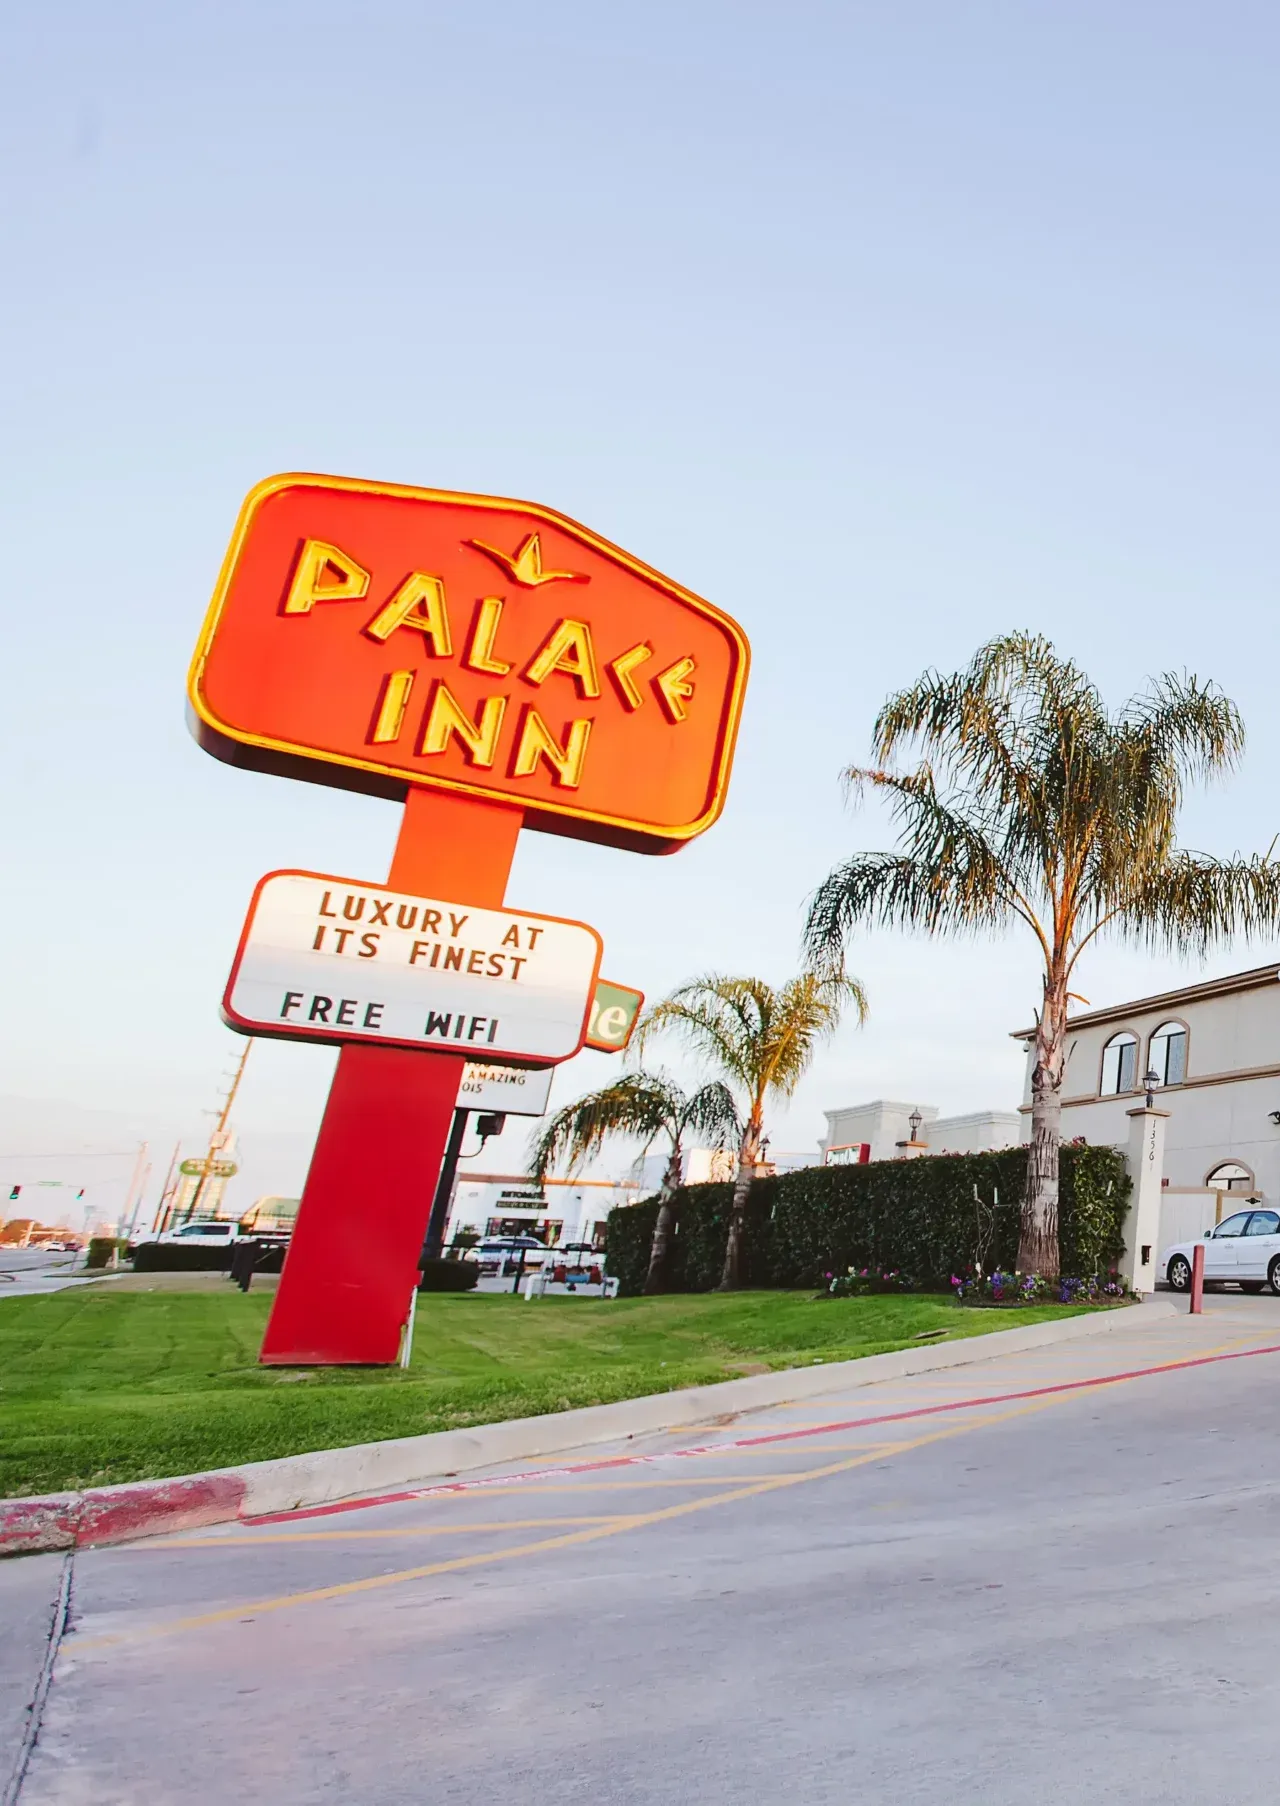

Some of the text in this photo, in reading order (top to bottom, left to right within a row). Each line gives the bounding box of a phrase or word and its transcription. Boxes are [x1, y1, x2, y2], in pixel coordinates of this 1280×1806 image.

[279, 538, 696, 723] PALACE
[368, 670, 593, 788] INN
[318, 891, 544, 951] LUXURY AT
[312, 925, 528, 980] ITS FINEST
[279, 991, 500, 1043] FREE WIFI
[468, 1070, 526, 1085] AMAZING
